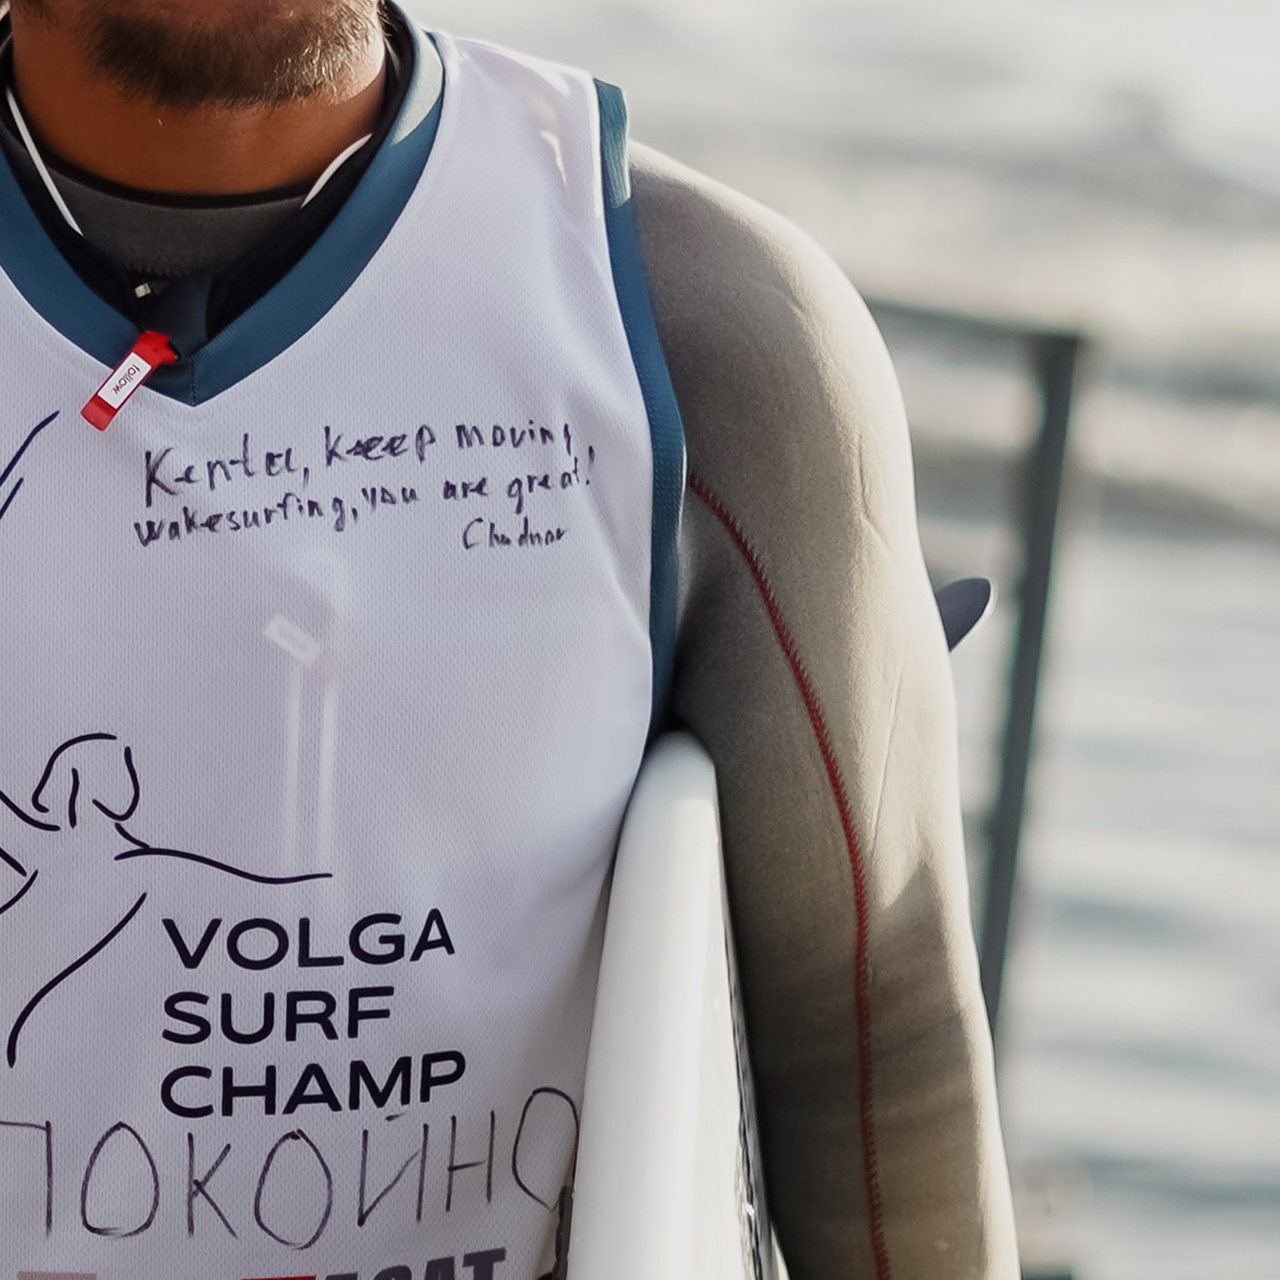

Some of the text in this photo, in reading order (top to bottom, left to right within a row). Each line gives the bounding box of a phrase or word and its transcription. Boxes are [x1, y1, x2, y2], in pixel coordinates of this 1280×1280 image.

[324, 423, 436, 467] keep
[443, 476, 489, 500] are
[161, 907, 456, 971] VOLGA
[161, 985, 395, 1045] SURF
[160, 1050, 467, 1119] CHAMP
